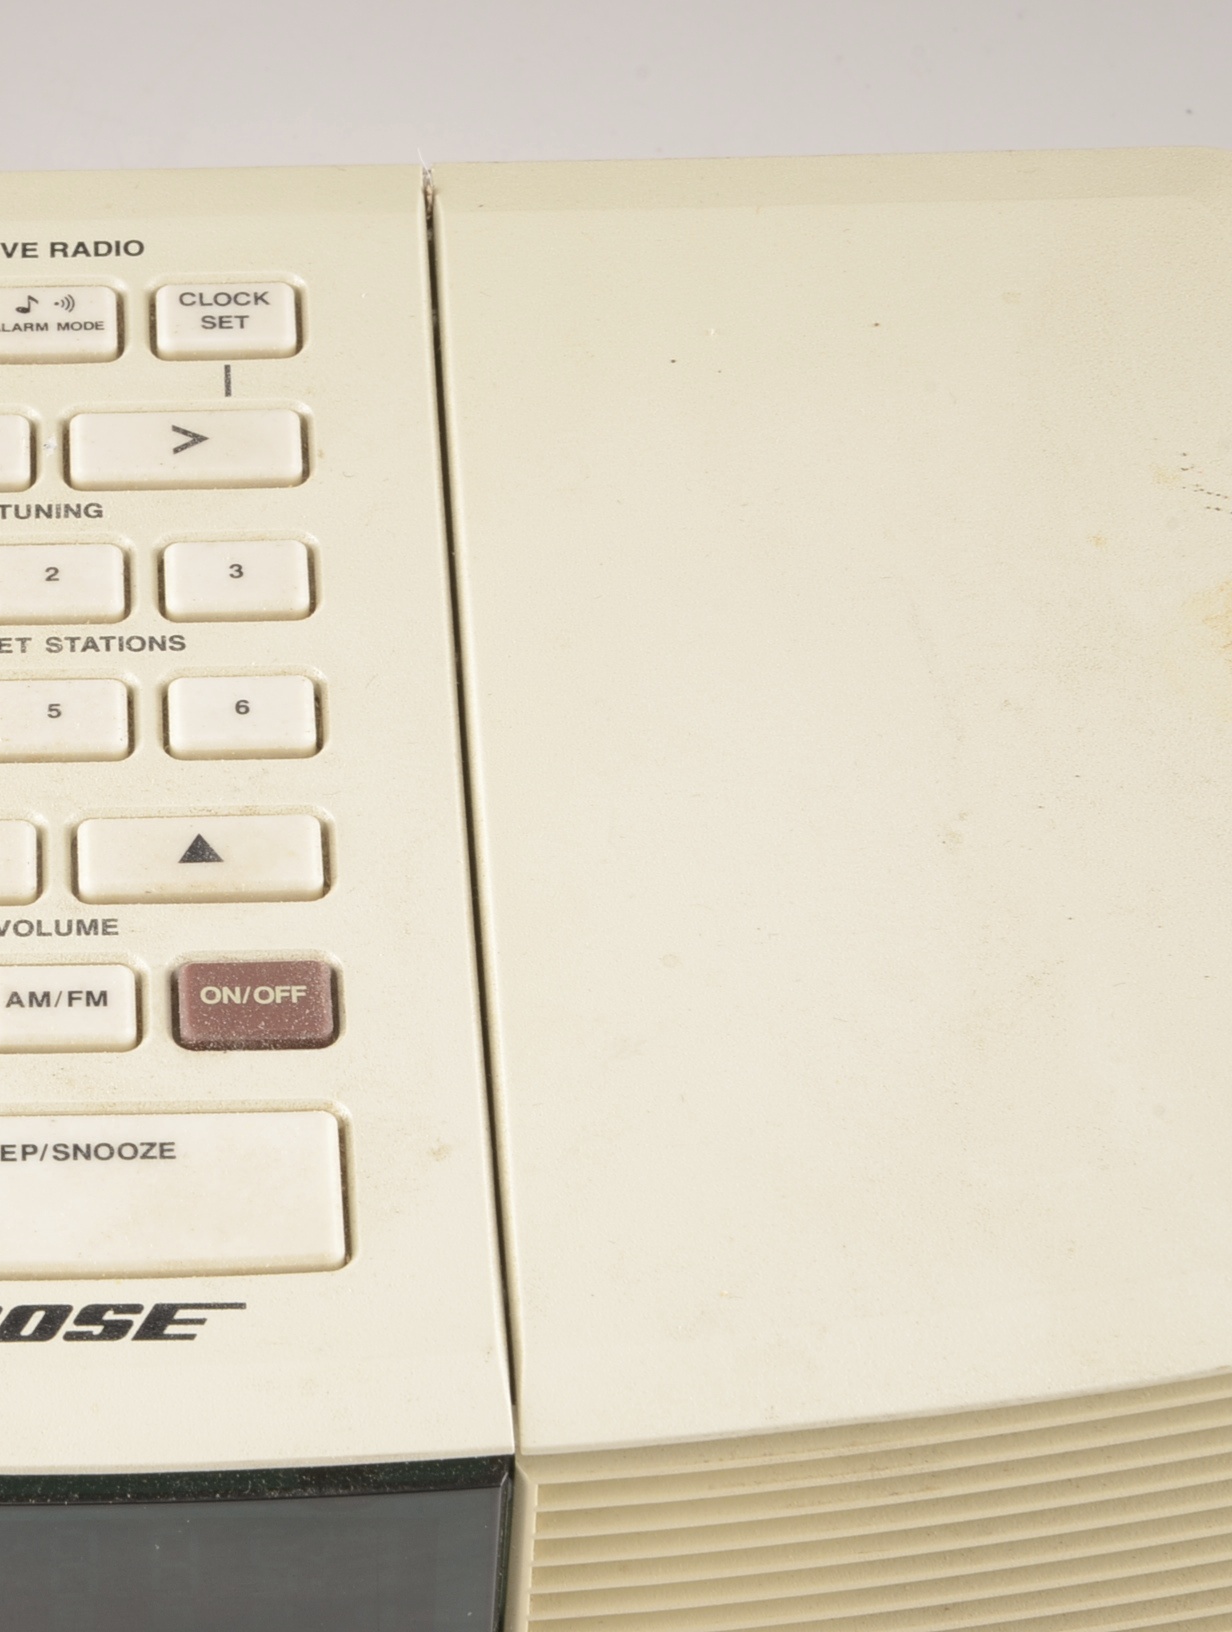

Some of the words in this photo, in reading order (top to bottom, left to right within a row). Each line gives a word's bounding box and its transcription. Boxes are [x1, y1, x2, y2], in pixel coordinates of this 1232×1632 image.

[49, 239, 145, 259] RADIO
[178, 291, 270, 307] CLOCK
[56, 320, 105, 332] MODE
[200, 314, 250, 330] SET
[45, 566, 60, 582] 2
[229, 563, 244, 579] 3
[45, 634, 187, 654] STATIONS
[47, 703, 62, 719] 5
[234, 699, 250, 716] 6
[5, 990, 108, 1009] AM/FM
[199, 985, 308, 1005] ON/OFF
